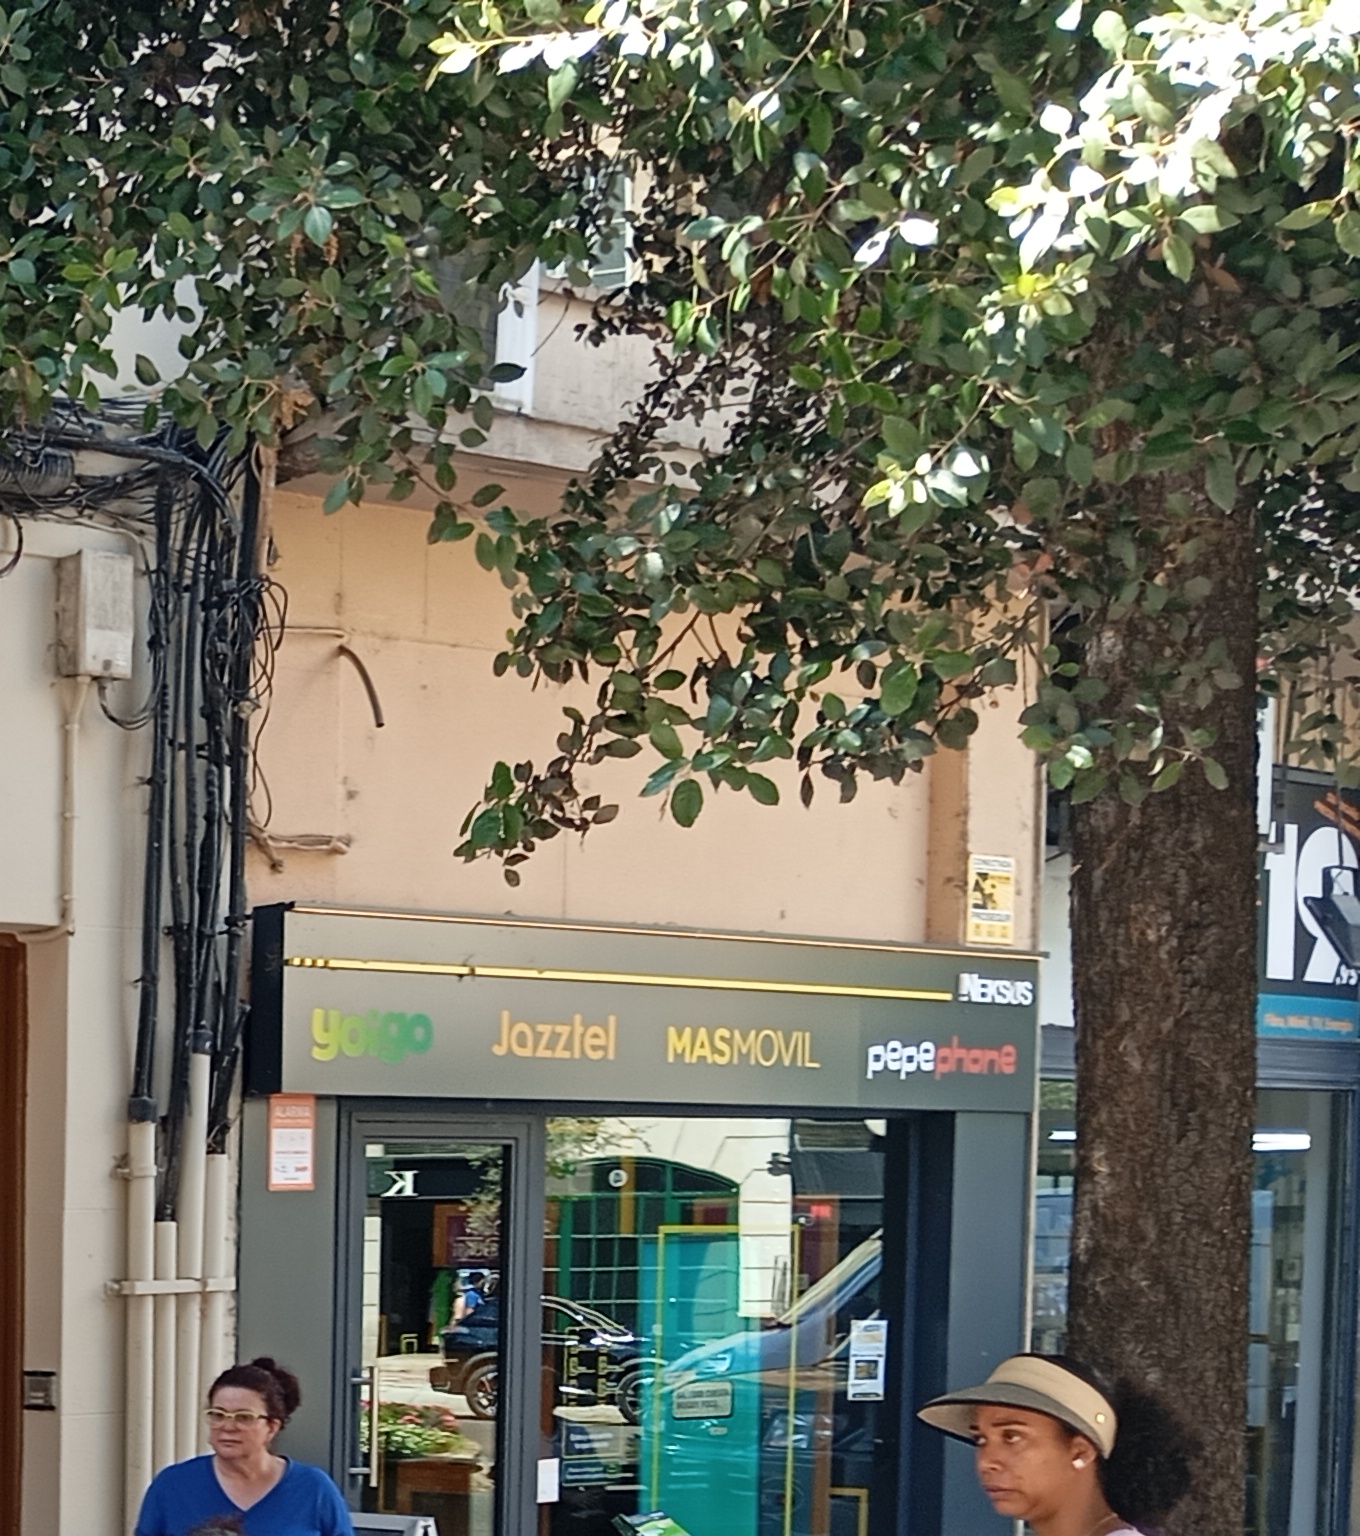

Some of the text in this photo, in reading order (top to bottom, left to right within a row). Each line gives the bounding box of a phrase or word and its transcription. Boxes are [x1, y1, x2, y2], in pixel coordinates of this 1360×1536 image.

[311, 1008, 1017, 1080] yoigo Jazztel MASMOVIL pepephone
